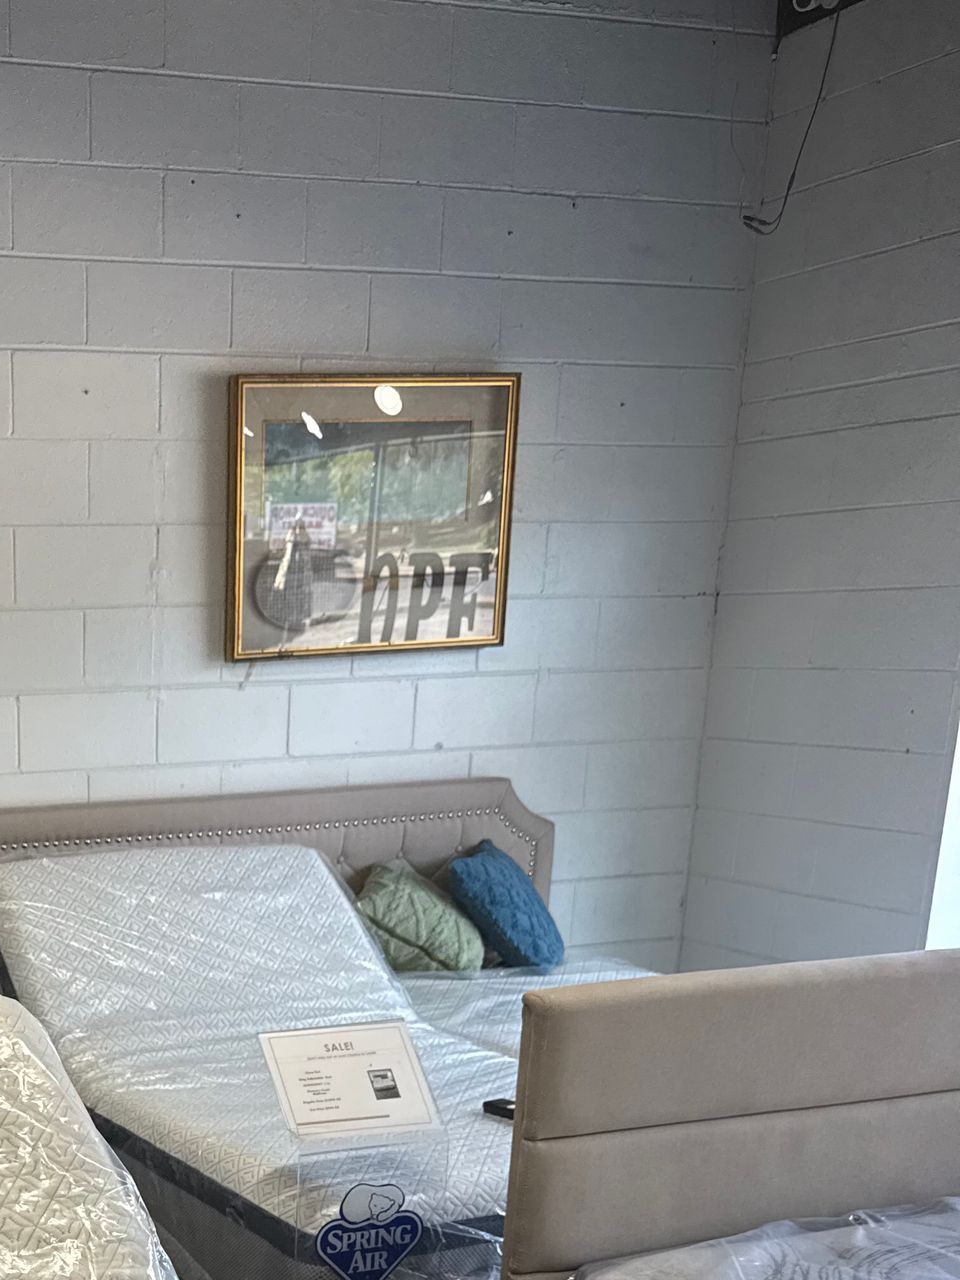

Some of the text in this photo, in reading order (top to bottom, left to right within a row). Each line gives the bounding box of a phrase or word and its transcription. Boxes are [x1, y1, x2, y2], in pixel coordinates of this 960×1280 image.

[323, 1041, 355, 1053] SALE!
[326, 1225, 412, 1254] SPRING
[347, 1250, 389, 1274] AIR
